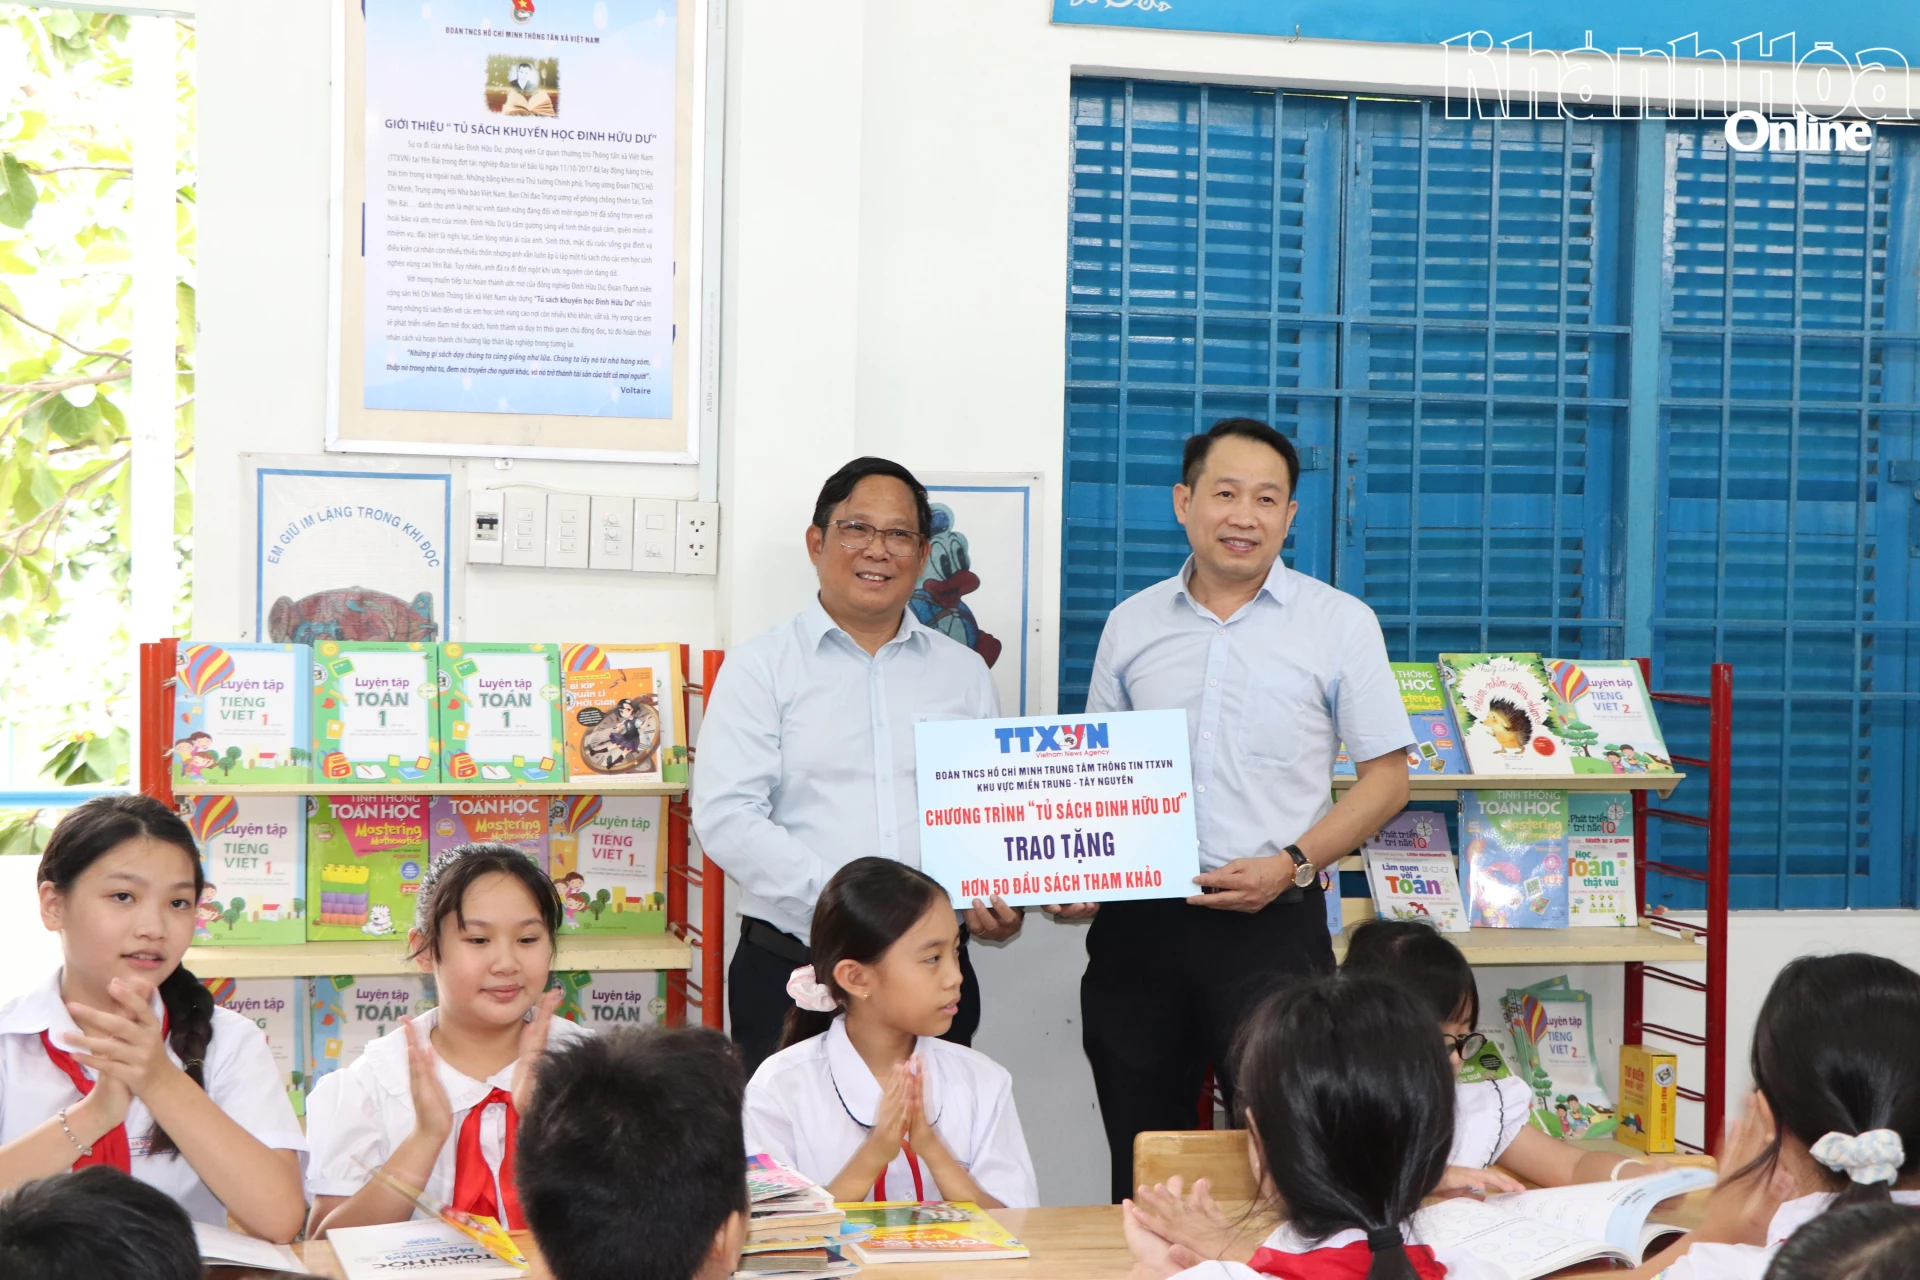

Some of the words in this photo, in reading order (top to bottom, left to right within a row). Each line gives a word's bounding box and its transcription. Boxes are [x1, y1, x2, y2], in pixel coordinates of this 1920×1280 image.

[465, 28, 482, 36] TNCS
[493, 29, 504, 38] CHÍ
[506, 30, 523, 39] MINH
[524, 31, 546, 40] THÔNG
[385, 118, 409, 130] GIỚI
[411, 120, 445, 134] THIỆU
[454, 121, 468, 134] TỦ
[471, 123, 501, 136] SÁCH
[504, 126, 548, 139] KHUYẾN
[551, 130, 575, 142] HỌC
[577, 130, 605, 142] ĐINH
[608, 131, 633, 143] HỮU
[620, 386, 652, 395] Voltaire
[268, 545, 286, 565] EM
[280, 522, 301, 545] GIỮ
[300, 514, 316, 530] IM
[317, 505, 353, 523] LẶNG
[357, 506, 402, 528] TRONG
[402, 522, 424, 543] KHI
[420, 540, 440, 568] ĐỌC
[220, 678, 260, 692] Luyện
[262, 678, 284, 693] tập
[355, 677, 389, 690] Luyện
[391, 677, 410, 690] tập
[478, 678, 512, 690] Luyện
[514, 678, 532, 691] tập
[1616, 678, 1632, 688] tập
[220, 693, 266, 708] TIẾNG
[354, 688, 410, 708] TOÁN
[478, 689, 532, 708] TOÁN
[1402, 693, 1442, 706] stering
[220, 708, 256, 723] VIỆT
[262, 713, 268, 726] 1
[1622, 704, 1631, 714] 2
[378, 709, 387, 728] 1
[502, 710, 511, 728] 1
[995, 722, 1109, 754] TTXVN
[1084, 749, 1110, 758] Agency
[935, 769, 960, 780] ĐOÀN
[962, 769, 985, 779] TNCS
[987, 766, 1000, 778] HỒ
[1001, 767, 1017, 777] CHÍ
[1018, 766, 1043, 776] MINH
[1044, 764, 1074, 774] TRUNG
[1076, 762, 1096, 773] TÂM
[1097, 760, 1126, 772] THÔNG
[1128, 760, 1144, 770] TIN
[1145, 759, 1174, 769] TTXVN
[976, 783, 996, 792] KHU
[997, 781, 1014, 792] VỰC
[1016, 778, 1040, 790] MIỀN
[1042, 778, 1072, 789] TRUNG
[1079, 776, 1096, 787] TÂY
[1097, 774, 1134, 786] NGUYÊN
[328, 803, 378, 819] TOÁN
[381, 804, 421, 822] HỌC
[449, 799, 498, 815] TOÁN
[500, 799, 540, 817] HỌC
[925, 806, 982, 826] CHƯƠNG
[984, 802, 1025, 824] TRÌNH
[1028, 798, 1052, 821] “TỦ
[1056, 798, 1092, 820] SÁCH
[1095, 799, 1129, 818] ĐINH
[1132, 795, 1159, 816] HỮU
[1162, 792, 1188, 814] DƯ”
[1477, 800, 1522, 815] TOÁN
[1524, 801, 1561, 818] HỌC
[223, 822, 263, 838] Luyện
[266, 823, 288, 838] tập
[355, 821, 422, 838] Mastering
[476, 817, 542, 833] Mastering
[593, 814, 629, 830] Luyện
[631, 816, 651, 832] tập
[1602, 821, 1616, 834] IQ
[224, 839, 270, 854] TIẾNG
[592, 830, 633, 848] TIẾNG
[1003, 834, 1056, 862] TRAO
[1060, 828, 1116, 864] TẶNG
[592, 847, 623, 862] VIỆT
[628, 854, 635, 867] 1
[1575, 850, 1592, 860] Học
[224, 854, 260, 872] VIỆT
[265, 861, 272, 875] 1
[1382, 862, 1398, 870] Làm
[1568, 856, 1615, 877] Toán
[960, 878, 990, 897] HƠN
[993, 878, 1009, 896] 50
[1012, 870, 1040, 895] ĐẦU
[1044, 872, 1080, 893] SÁCH
[1083, 872, 1122, 891] THAM
[1125, 864, 1162, 890] KHẢO
[1385, 874, 1442, 895] Toán
[1604, 877, 1619, 887] vui
[356, 988, 389, 1002] Luyện
[391, 989, 410, 1002] tập
[592, 990, 622, 1003] Luyện
[624, 990, 642, 1004] tập
[263, 997, 285, 1013] tập
[592, 1002, 641, 1022] TOÁN
[1571, 1046, 1578, 1058] 2
